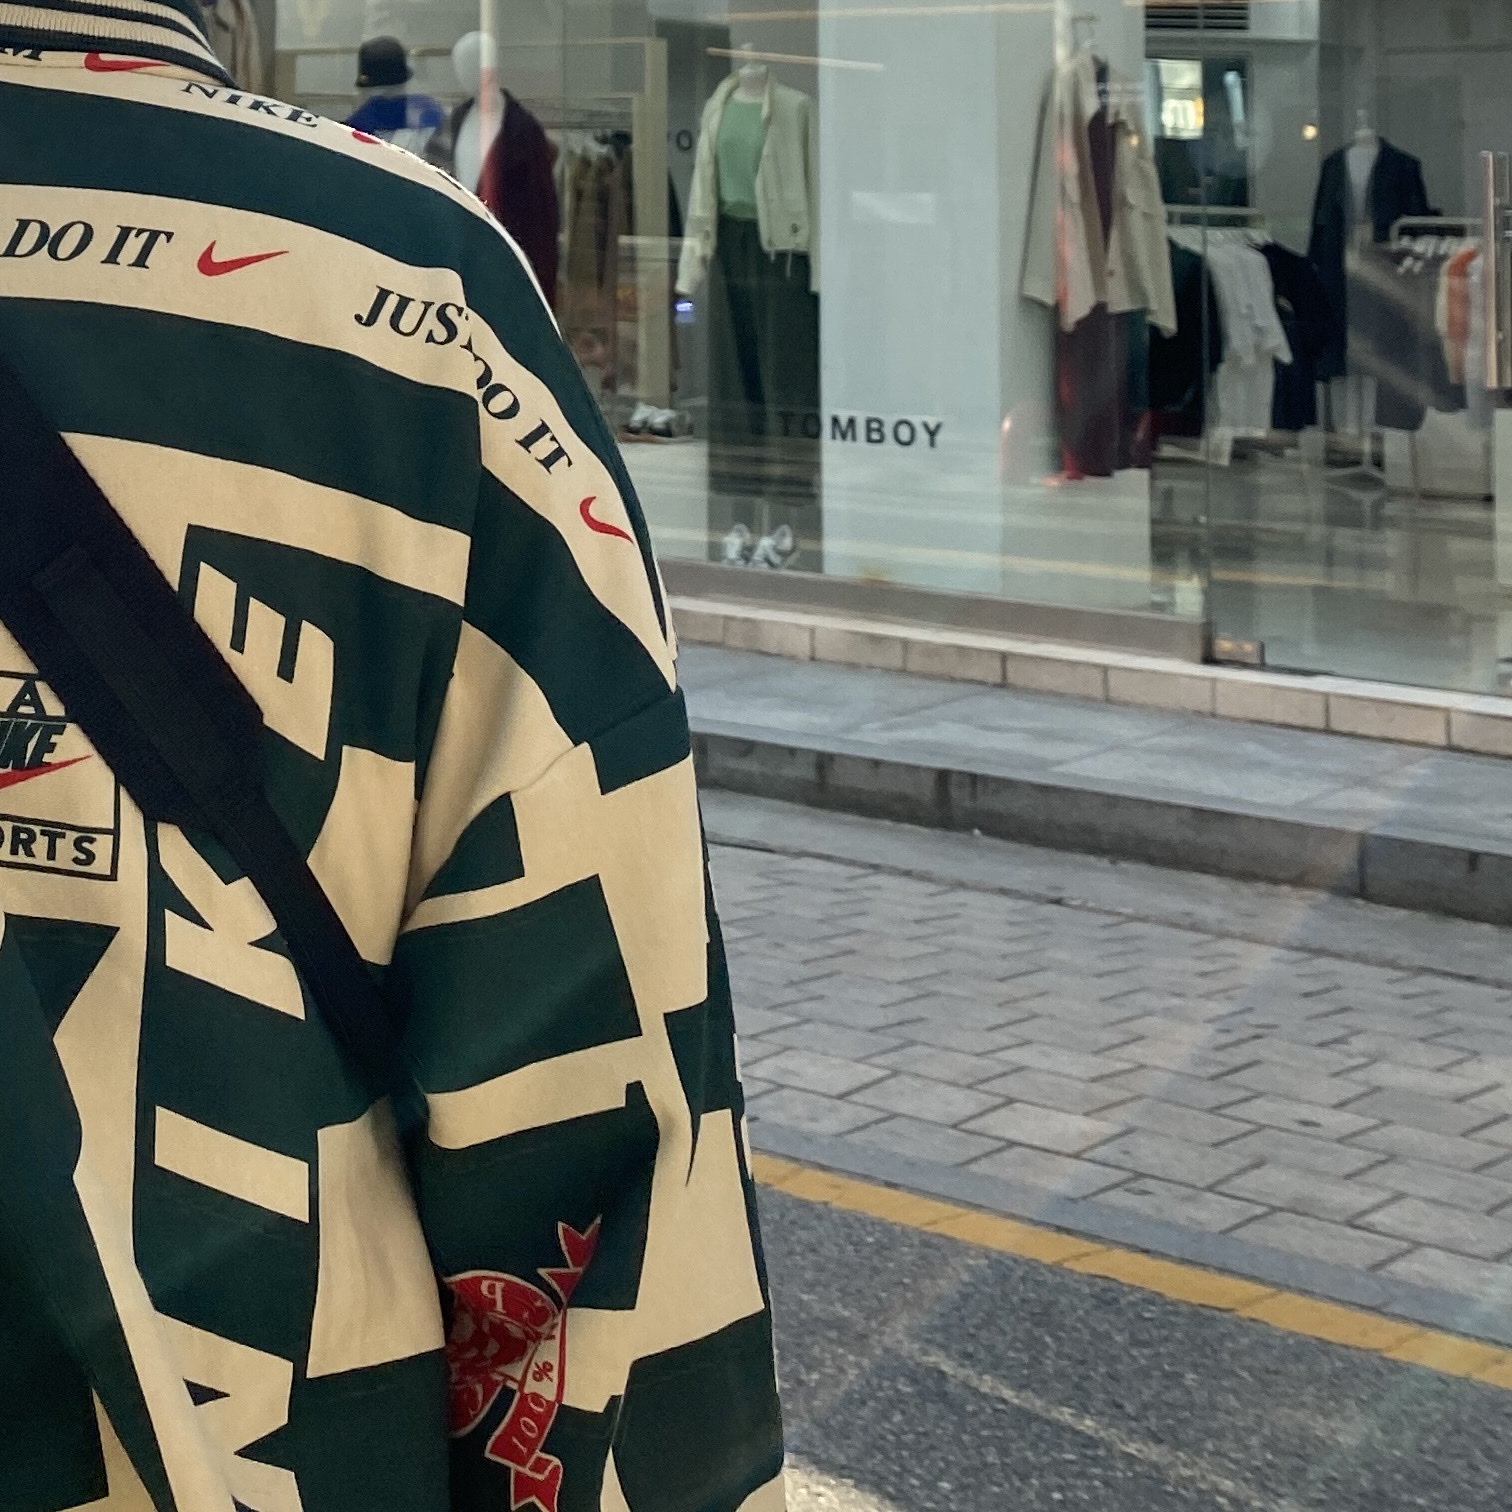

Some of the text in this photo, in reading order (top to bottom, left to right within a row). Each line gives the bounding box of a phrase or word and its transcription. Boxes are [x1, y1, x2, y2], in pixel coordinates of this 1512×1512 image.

[180, 82, 320, 128] NIKE
[100, 224, 175, 270] IT
[514, 418, 573, 475] IT
